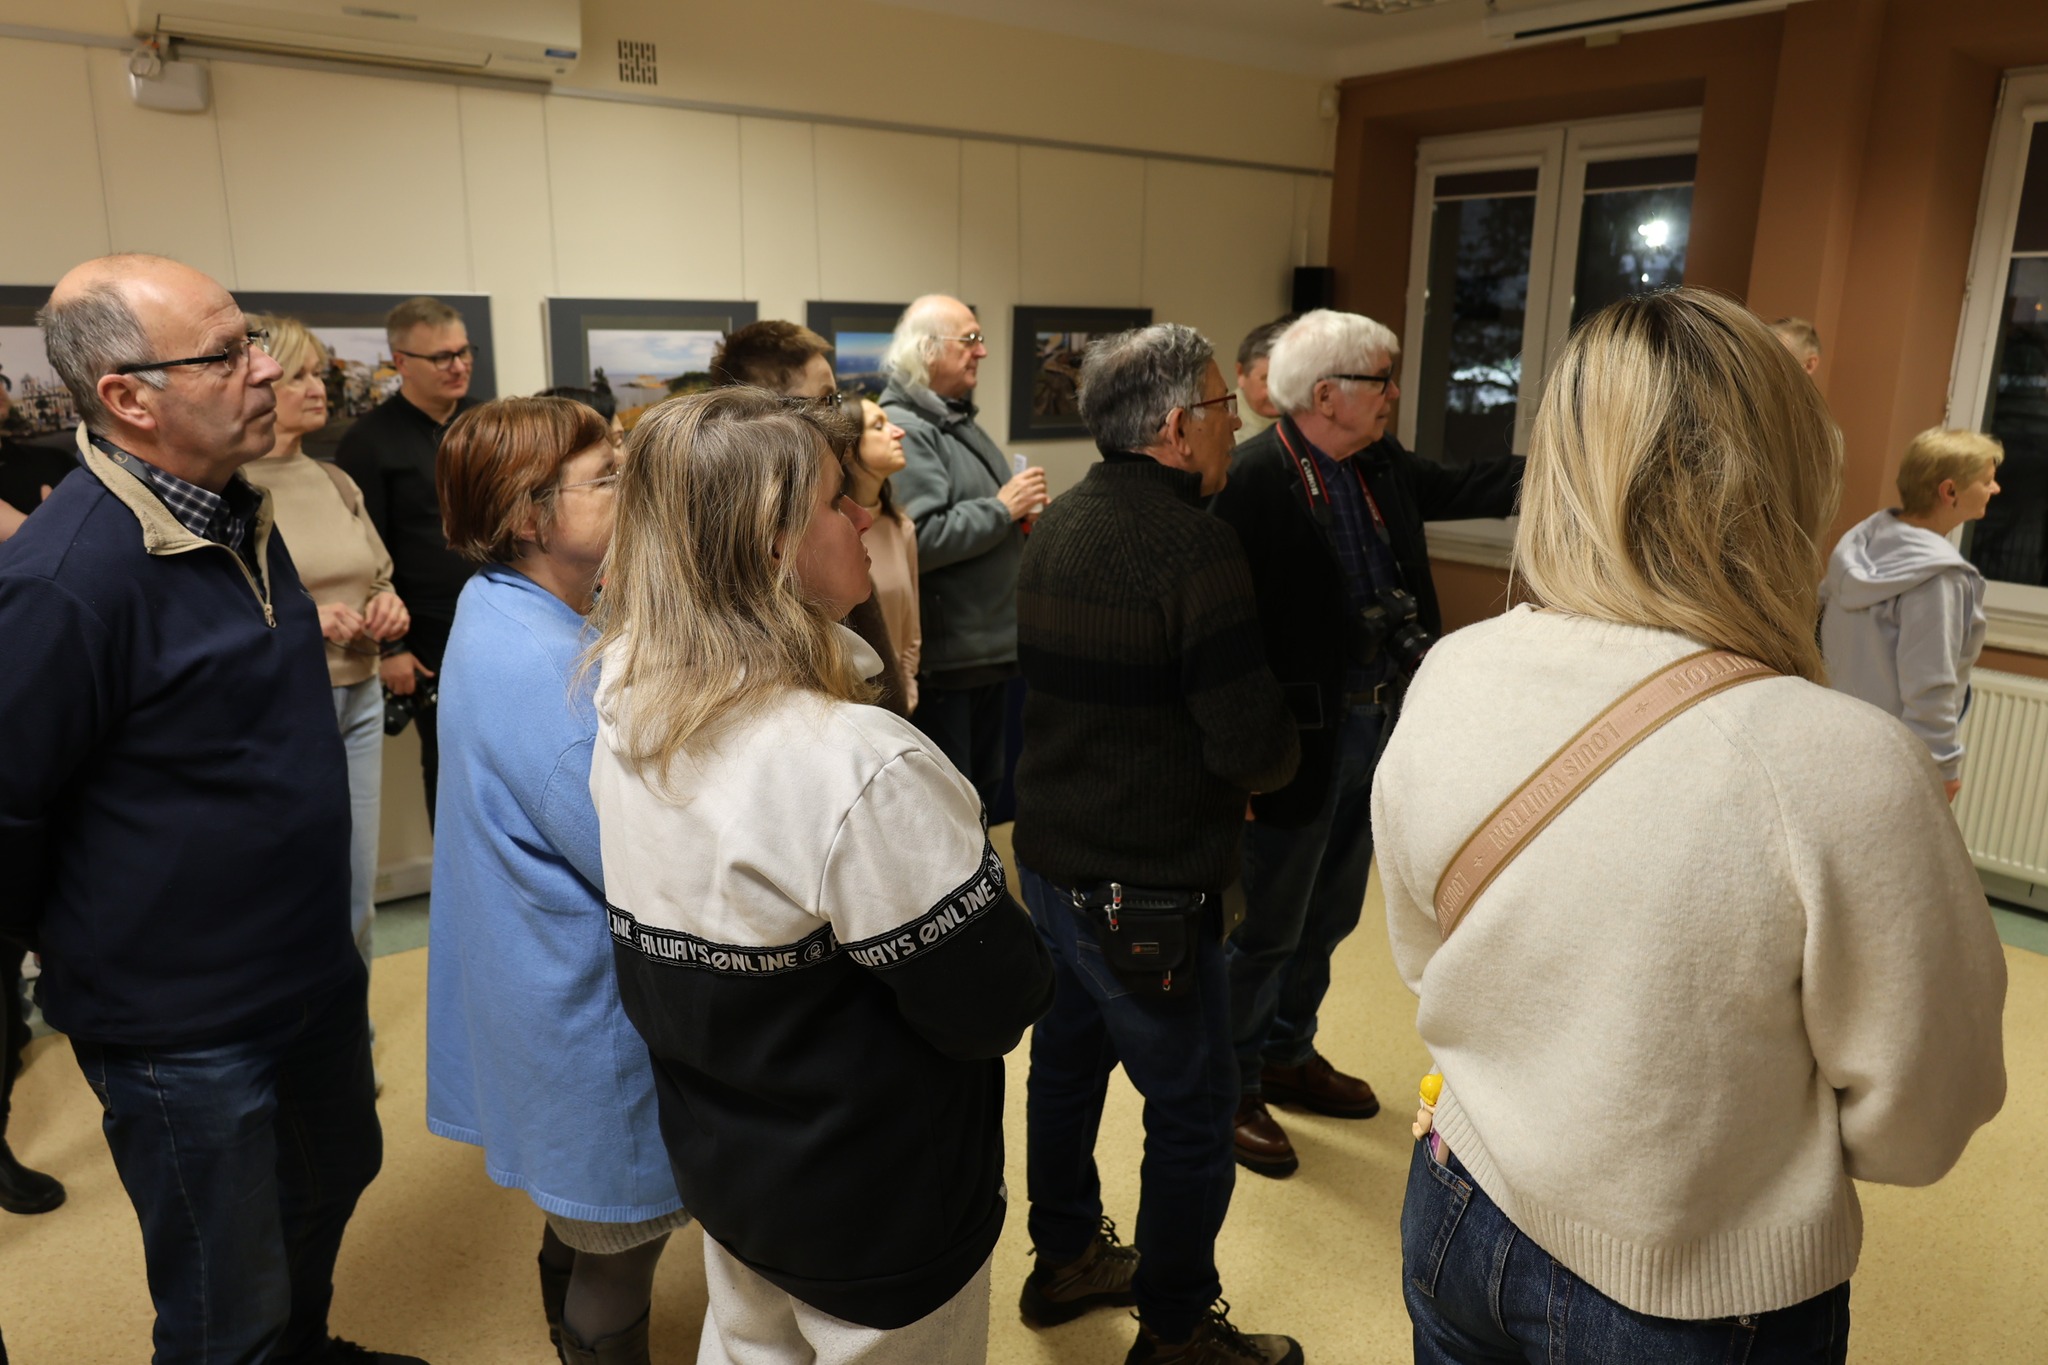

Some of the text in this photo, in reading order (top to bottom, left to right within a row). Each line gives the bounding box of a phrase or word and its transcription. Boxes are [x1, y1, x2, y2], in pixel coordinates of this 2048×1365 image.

[1300, 457, 1320, 496] Canon
[1488, 720, 1621, 850] LOUIS VUITTON
[1443, 870, 1471, 912] LOUIS
[640, 933, 711, 964] ALWAYS
